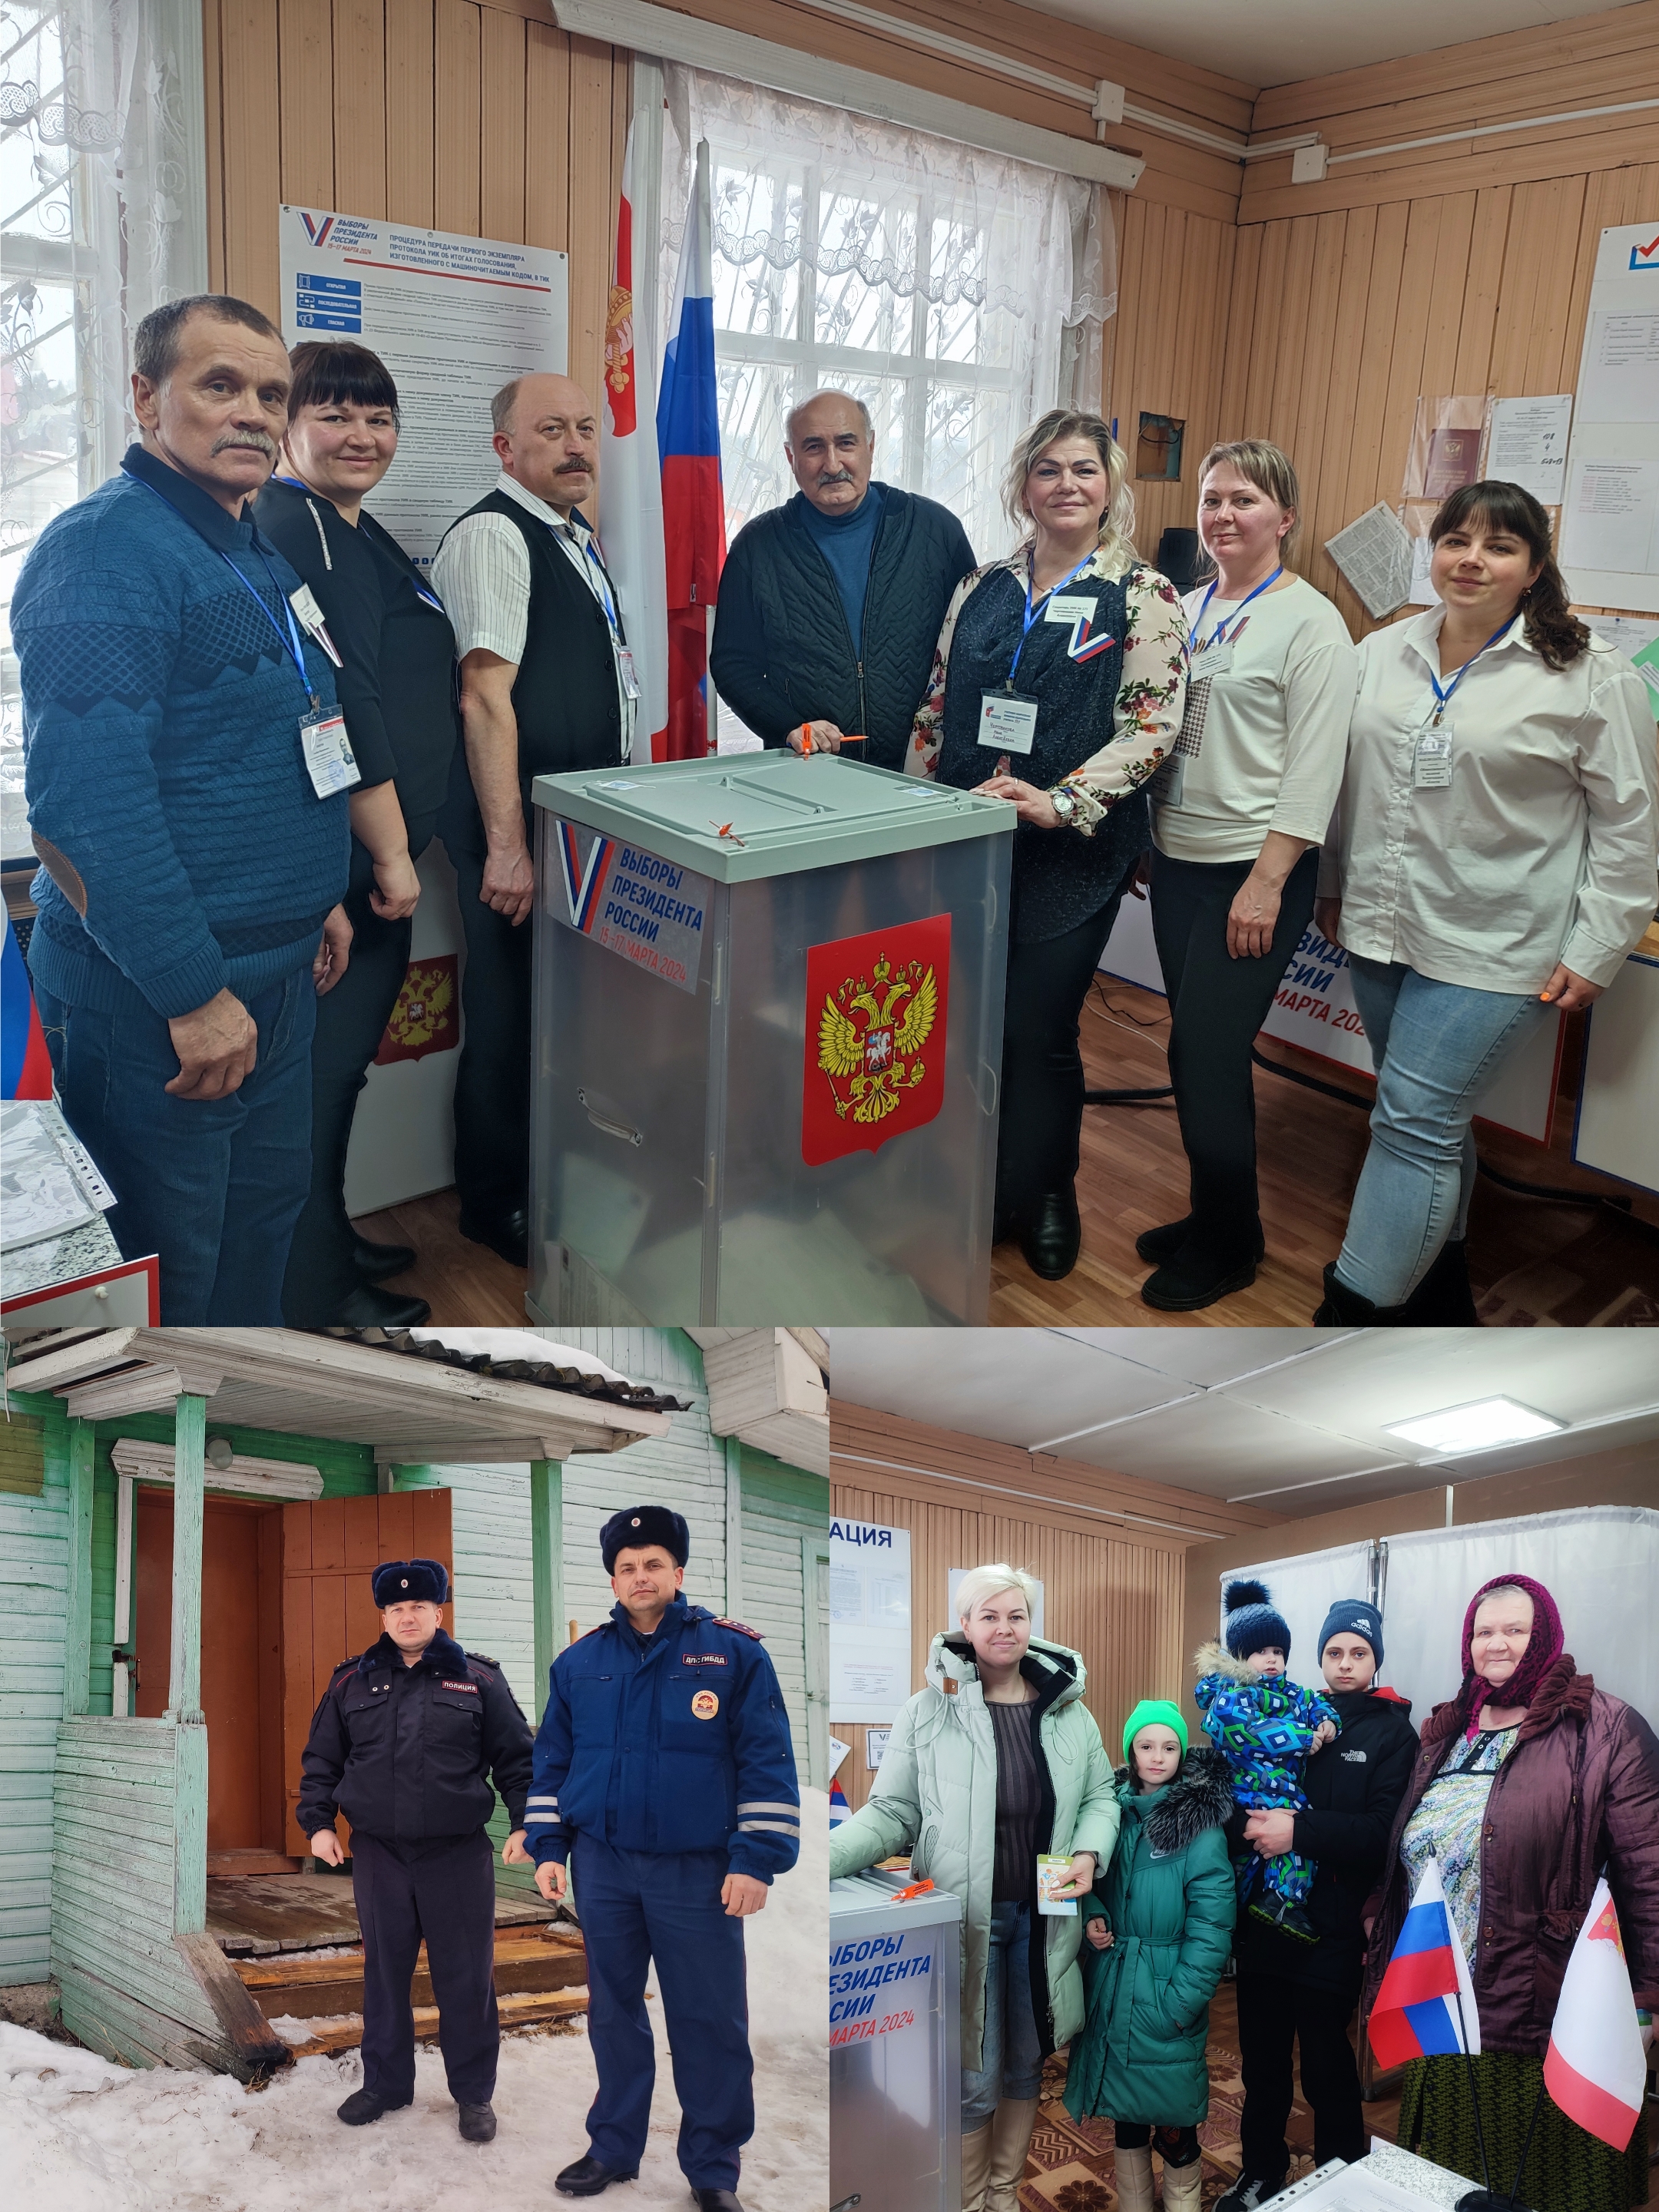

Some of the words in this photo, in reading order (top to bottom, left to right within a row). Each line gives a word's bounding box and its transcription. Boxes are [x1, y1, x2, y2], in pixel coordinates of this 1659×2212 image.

[333, 227, 378, 240] ПРЕЗИДЕНТА
[337, 219, 369, 230] ВЫБОРЫ
[330, 235, 359, 245] РОССИИ
[342, 245, 359, 253] МАРТА
[389, 234, 426, 247] ПРОЦЕДУРА
[427, 241, 459, 252] ПЕРЕДАЧИ
[460, 247, 486, 257] ПЕРВОГО
[488, 250, 525, 262] ЭКЗЕМПЛЯРА
[389, 244, 427, 255] ПРОТОКОЛА
[450, 253, 473, 263] ИТОГАХ
[474, 257, 517, 270] ГОЛОСОВАНИЯ,
[389, 253, 445, 267] ИЗГОТОВЛЕННОГО
[452, 262, 511, 276] МАШИНОЧИТАЕМЫМ
[512, 272, 534, 281] КОДОМ,
[620, 848, 684, 890] ВЫБОРЫ
[611, 875, 704, 932] ПРЕЗИДЕНТА
[604, 901, 660, 942] РОССИИ
[625, 939, 657, 971] МАРТА
[659, 957, 687, 983] 2024
[1295, 931, 1349, 969] ЗИД
[1273, 988, 1331, 1022] МАРТА
[830, 1522, 892, 1548] АЦИЯ
[1351, 1622, 1373, 1637] adidas
[701, 1656, 725, 1664] ГИБДД
[444, 1682, 476, 1691] ПОЛИЦИЯ
[830, 1955, 931, 1995] ЕЗИДЕНТА
[830, 1993, 876, 2023] СИИ
[830, 2018, 876, 2047] МАРТА
[879, 2008, 915, 2035] 2024
